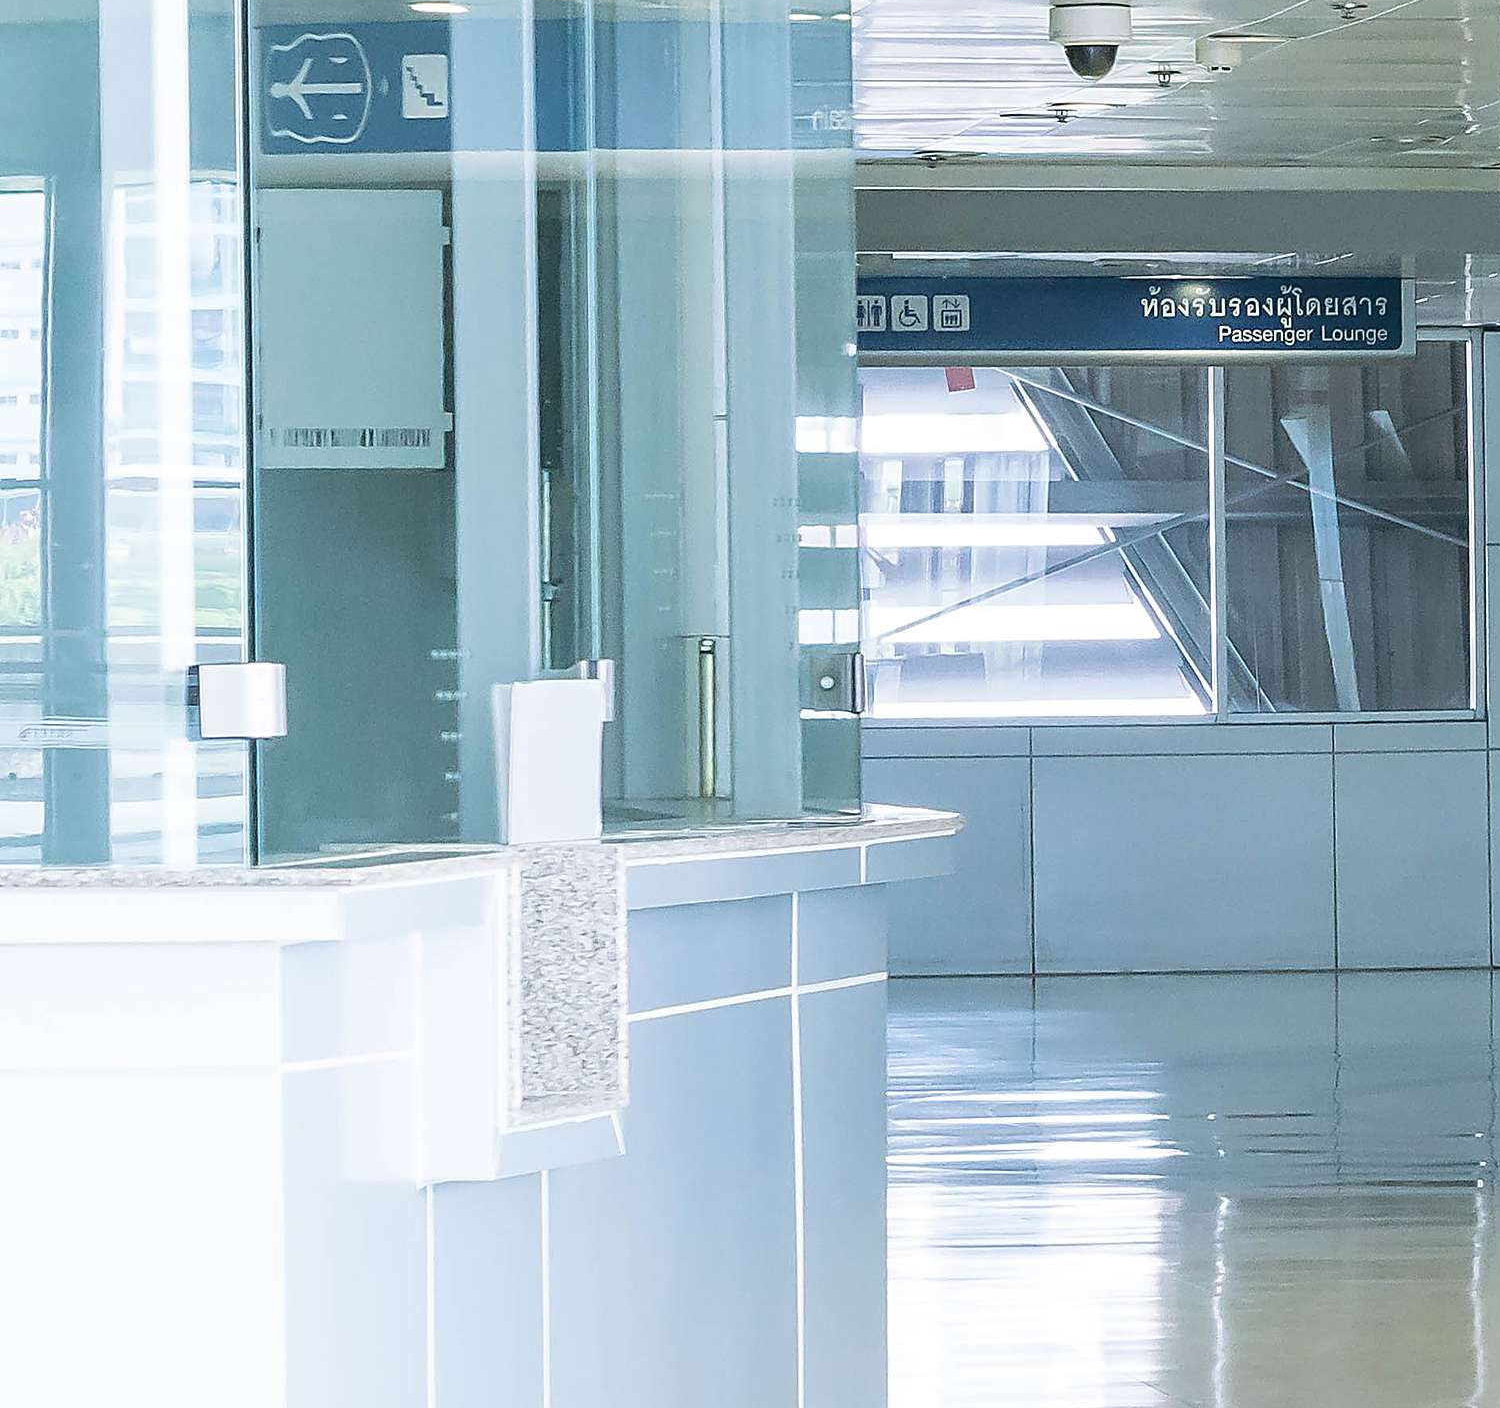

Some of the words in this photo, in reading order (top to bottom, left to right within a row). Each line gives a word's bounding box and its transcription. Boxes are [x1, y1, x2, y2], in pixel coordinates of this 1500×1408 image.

[1140, 284, 1389, 329] ห้องรับรองผู้โดยสาร
[1218, 325, 1314, 345] Passenger
[1321, 325, 1388, 345] Lounge
